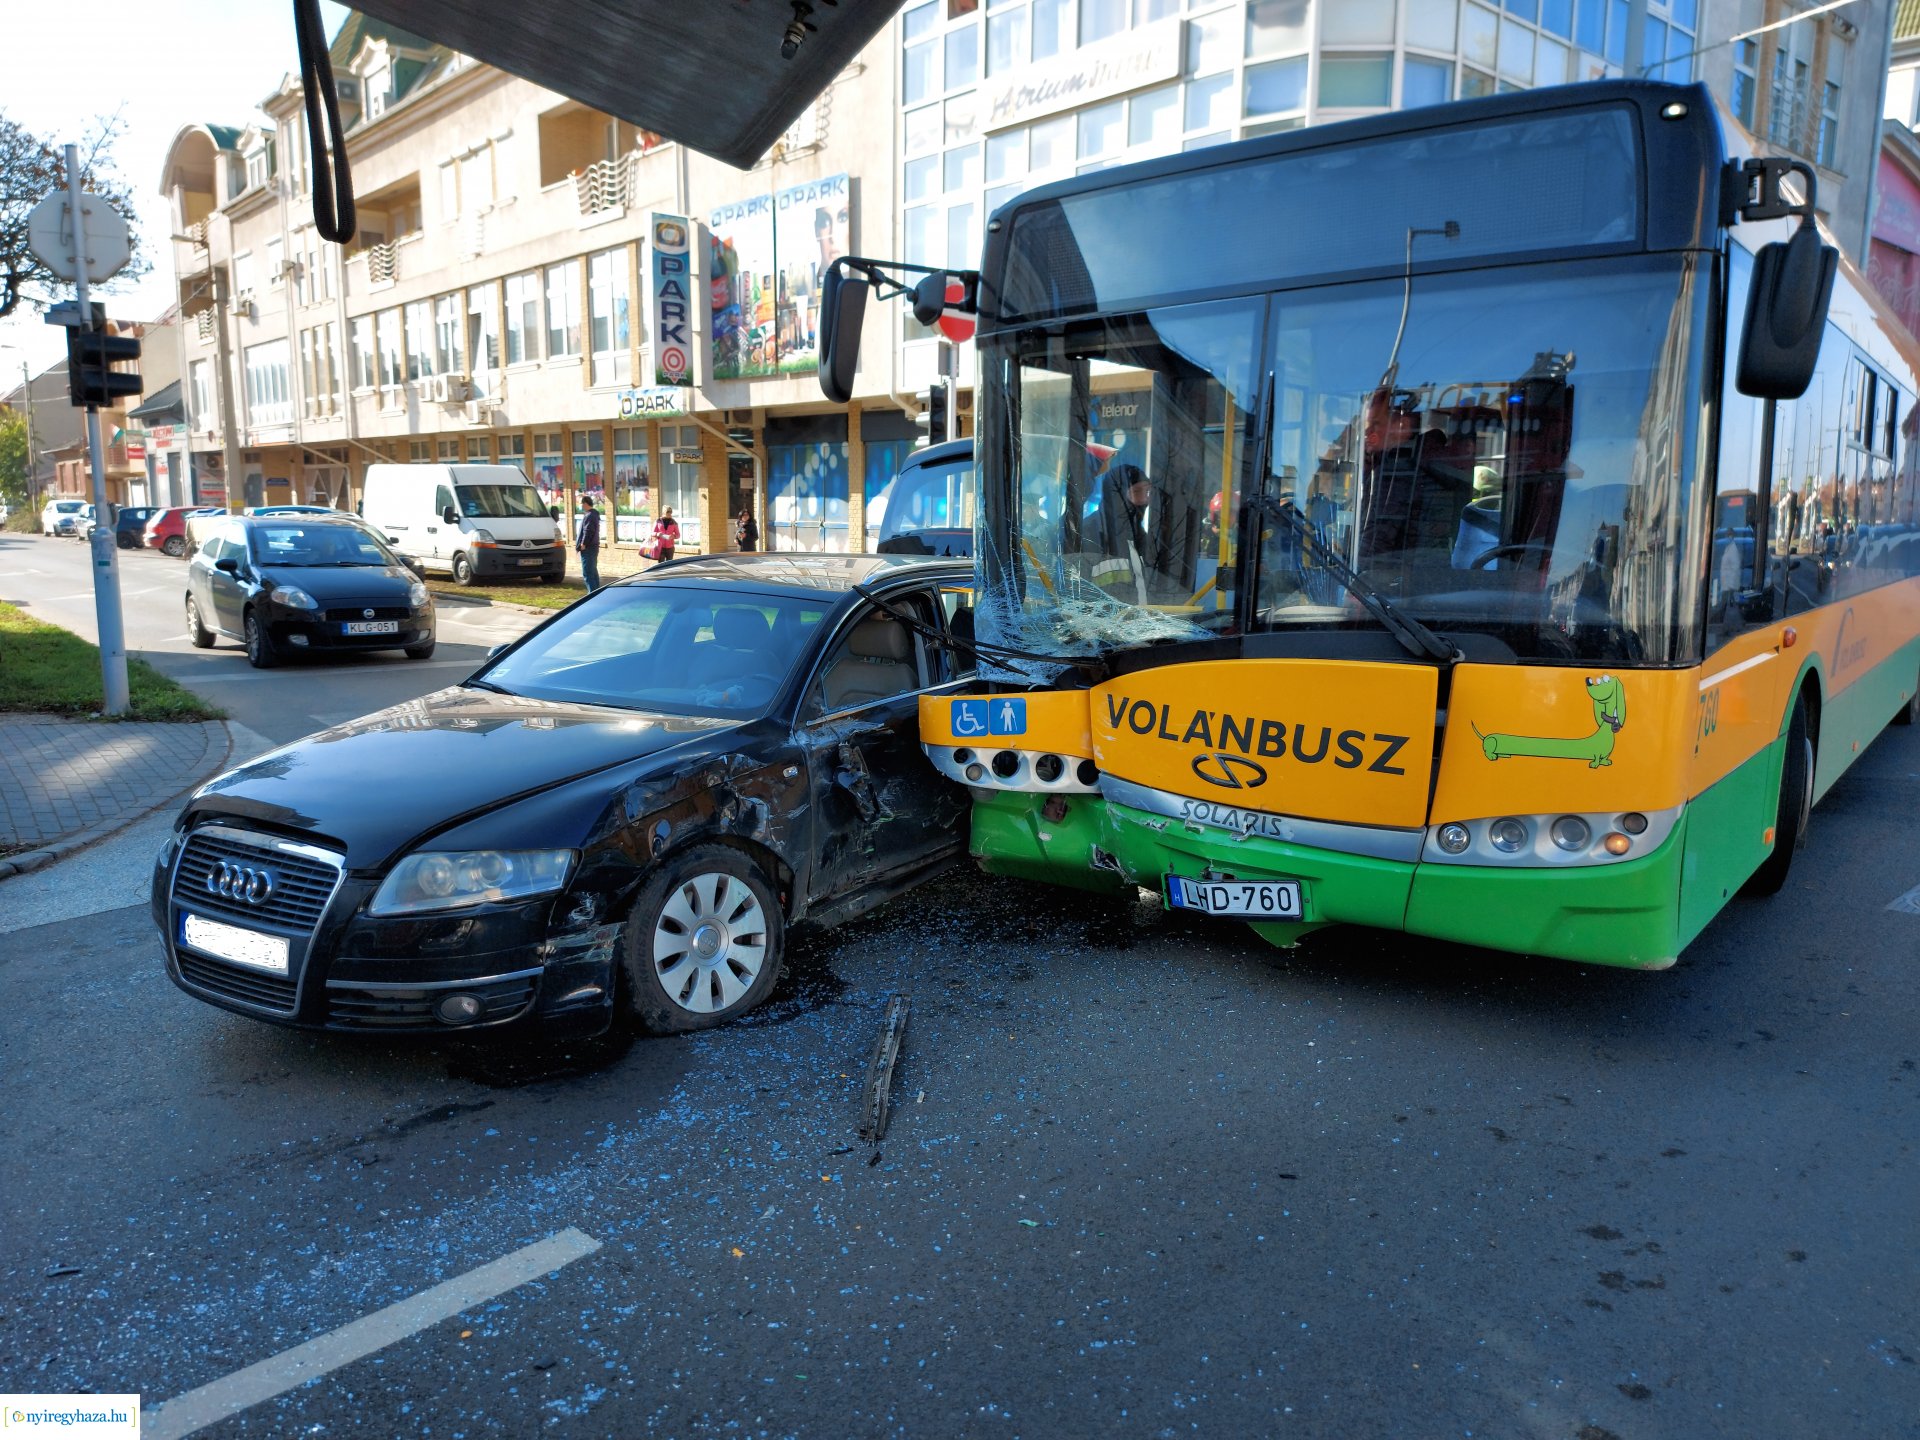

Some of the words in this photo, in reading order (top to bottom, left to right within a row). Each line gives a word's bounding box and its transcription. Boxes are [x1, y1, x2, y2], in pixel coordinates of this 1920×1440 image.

[636, 394, 675, 412] PARK
[1102, 403, 1138, 417] telenor
[350, 622, 395, 632] KLG-051
[1697, 687, 1720, 740] 760
[1107, 694, 1410, 776] VOLÁNBUSZ
[1180, 799, 1282, 837] SOLARIS
[1184, 881, 1292, 912] LHD-760
